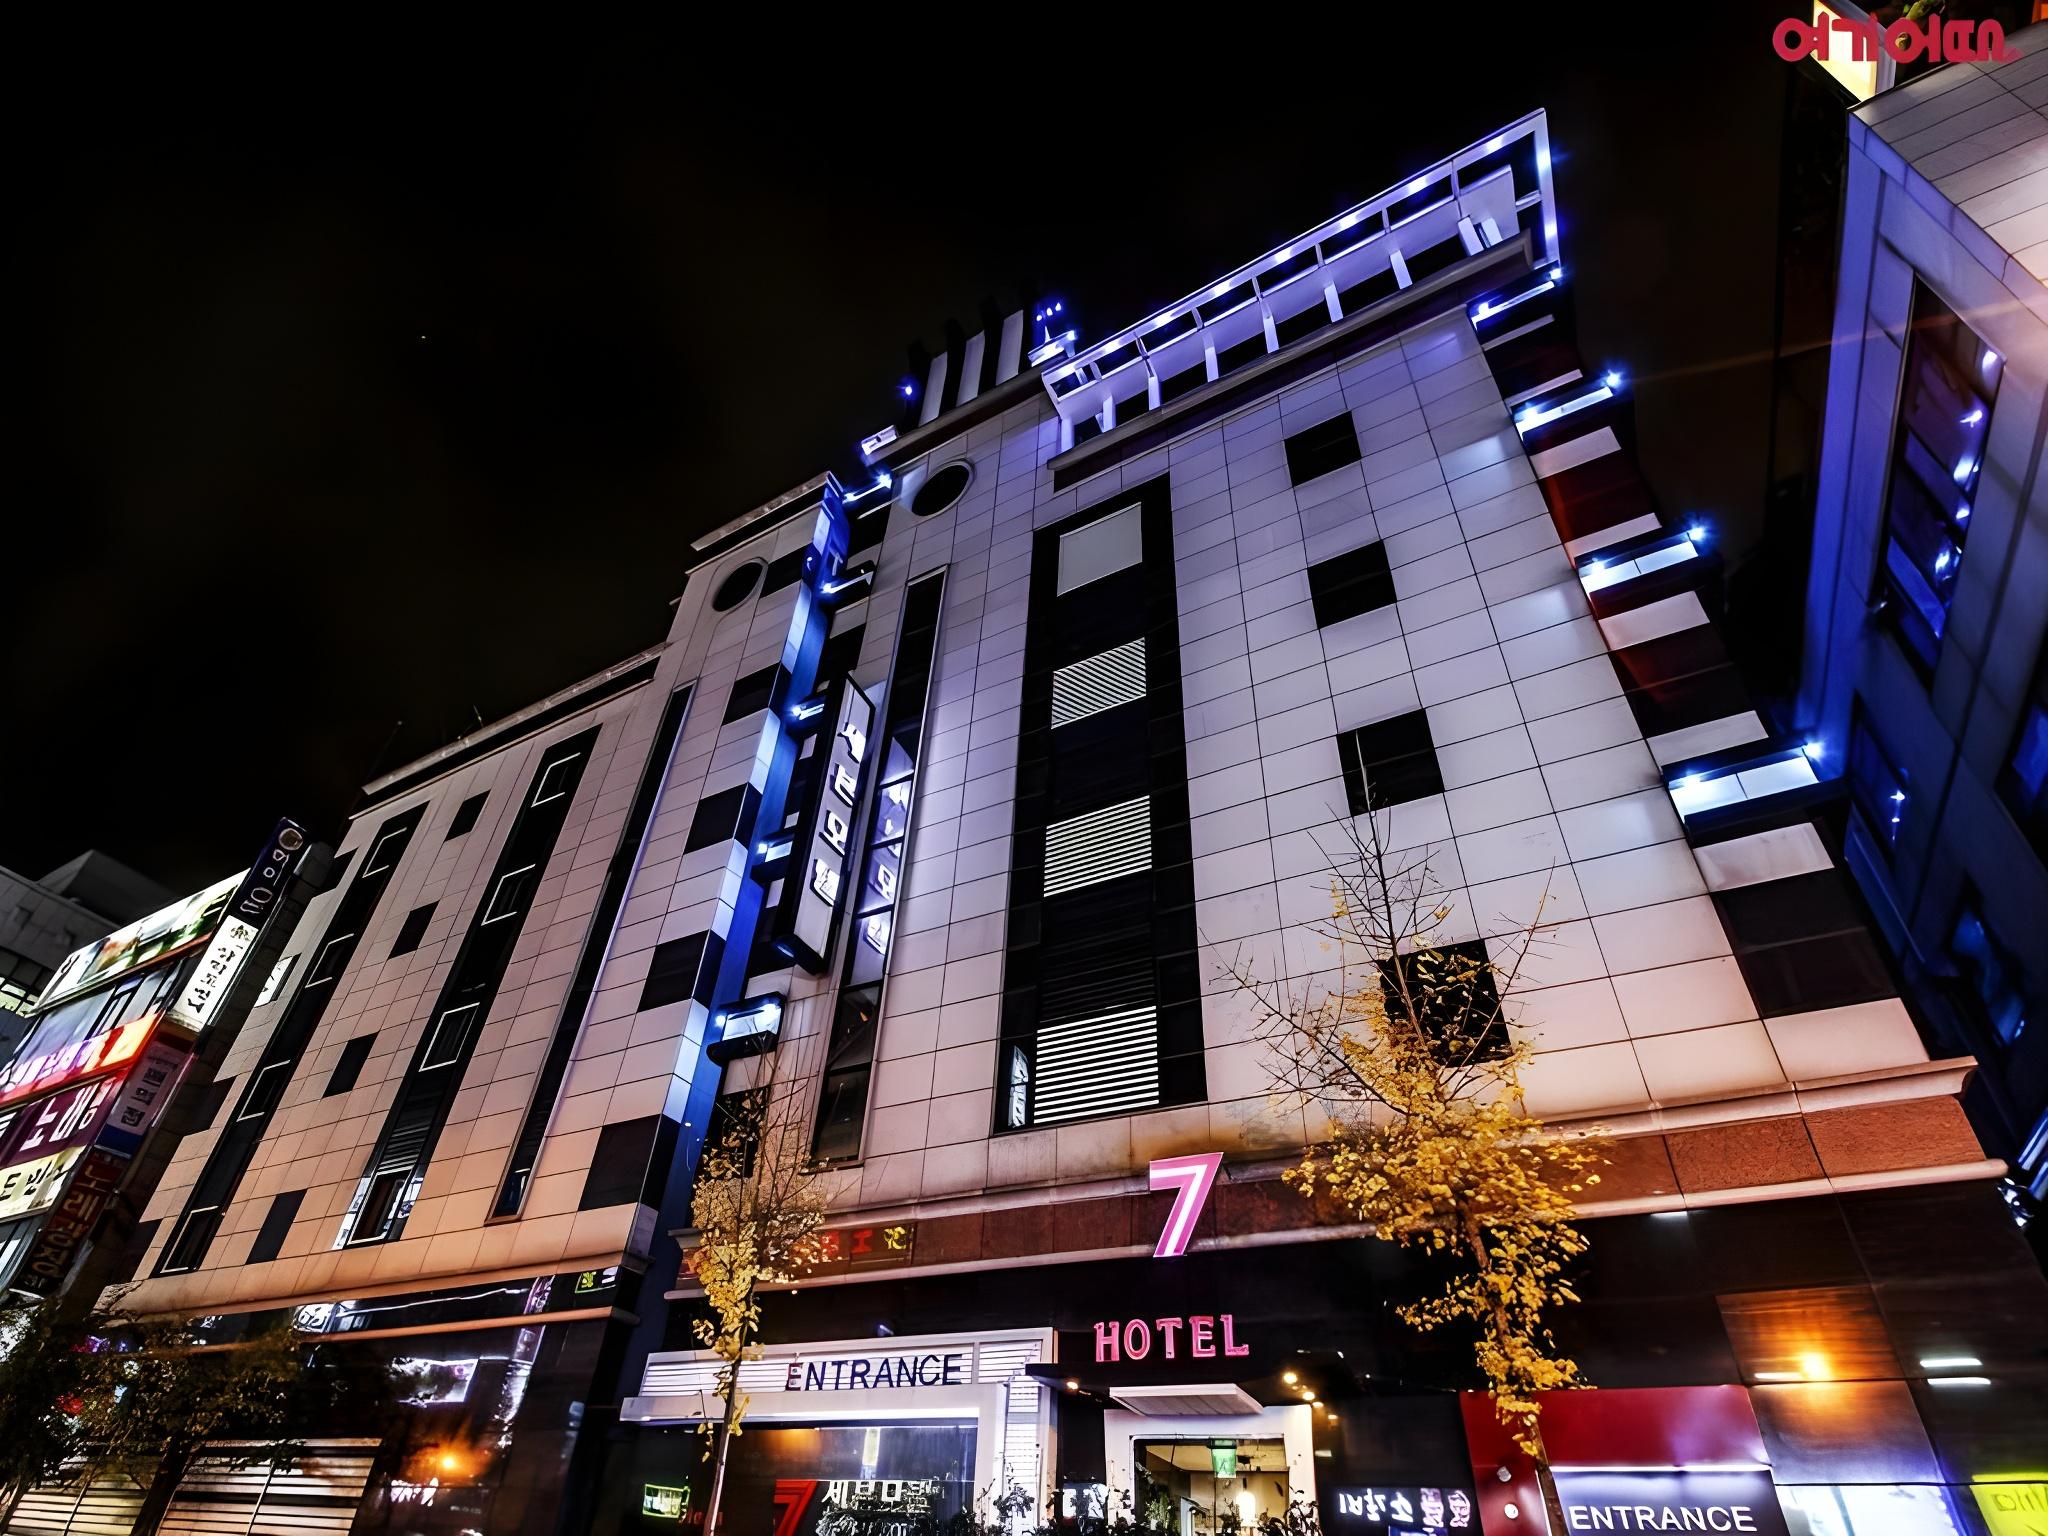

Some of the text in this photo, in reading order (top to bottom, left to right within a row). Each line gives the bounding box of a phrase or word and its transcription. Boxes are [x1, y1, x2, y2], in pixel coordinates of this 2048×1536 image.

[1149, 1152, 1224, 1257] 7
[1094, 1314, 1250, 1362] HOTEL
[785, 1353, 963, 1391] ENTRANCE
[1568, 1506, 1758, 1532] ENTRANCE
